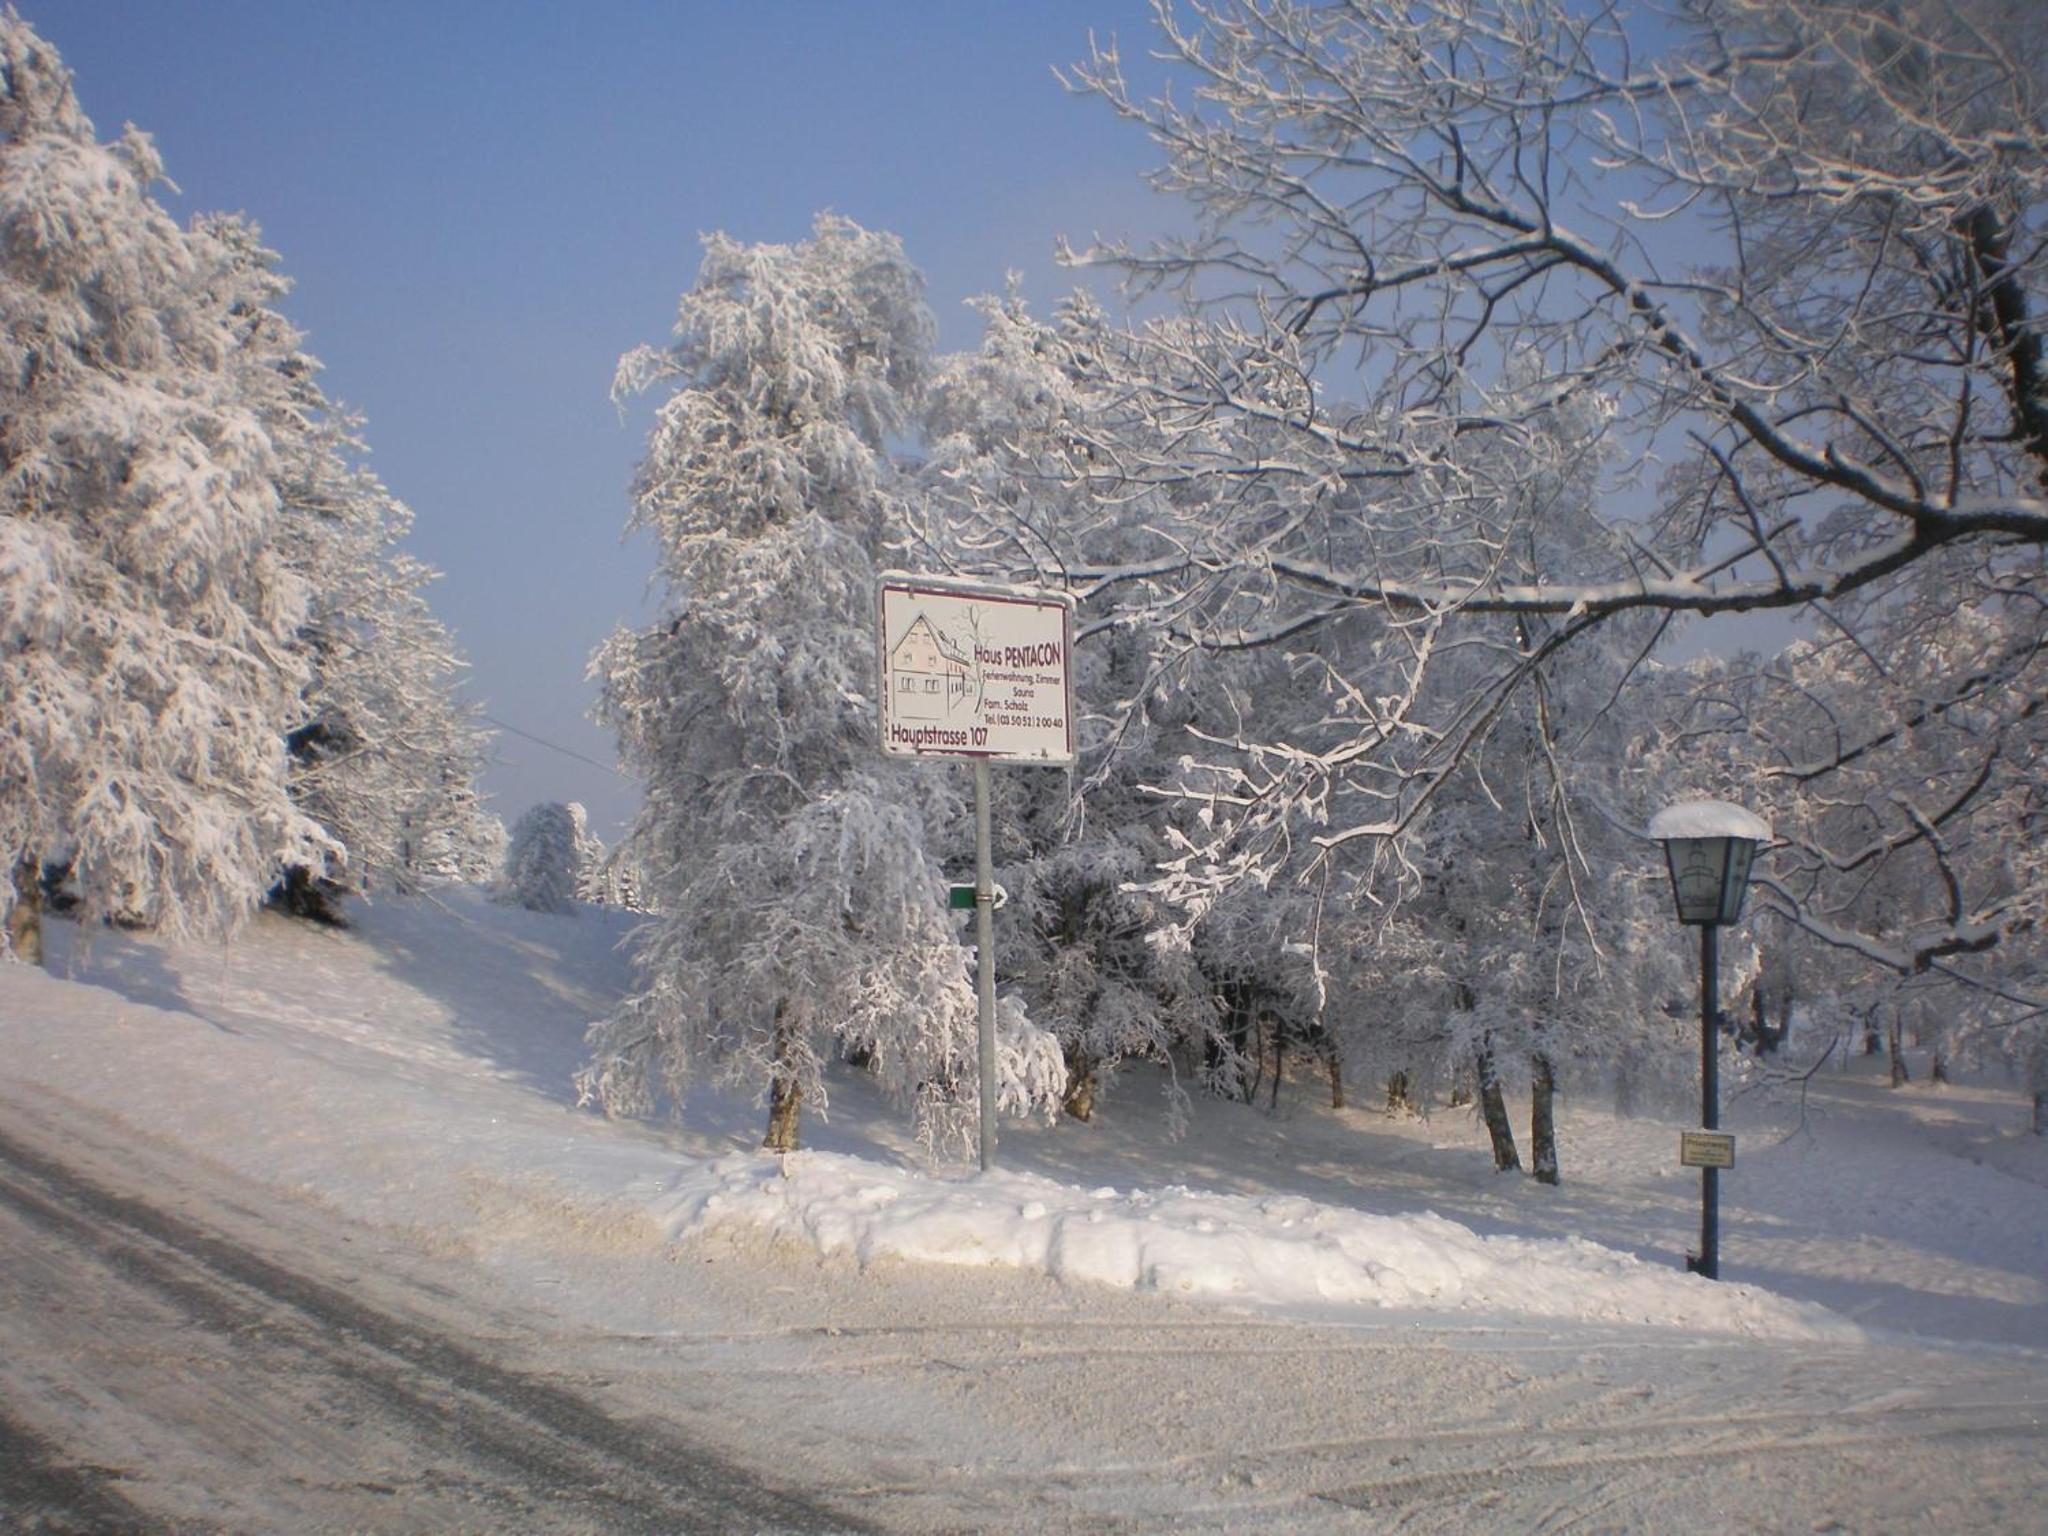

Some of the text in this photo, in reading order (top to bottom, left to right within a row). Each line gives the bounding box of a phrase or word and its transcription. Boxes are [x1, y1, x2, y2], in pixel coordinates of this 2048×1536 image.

[974, 642, 1061, 668] Haus PENTACON
[1035, 673, 1061, 685] Zimmer
[1013, 686, 1035, 698] Sauna
[891, 723, 989, 747] Hauptstrasse 107
